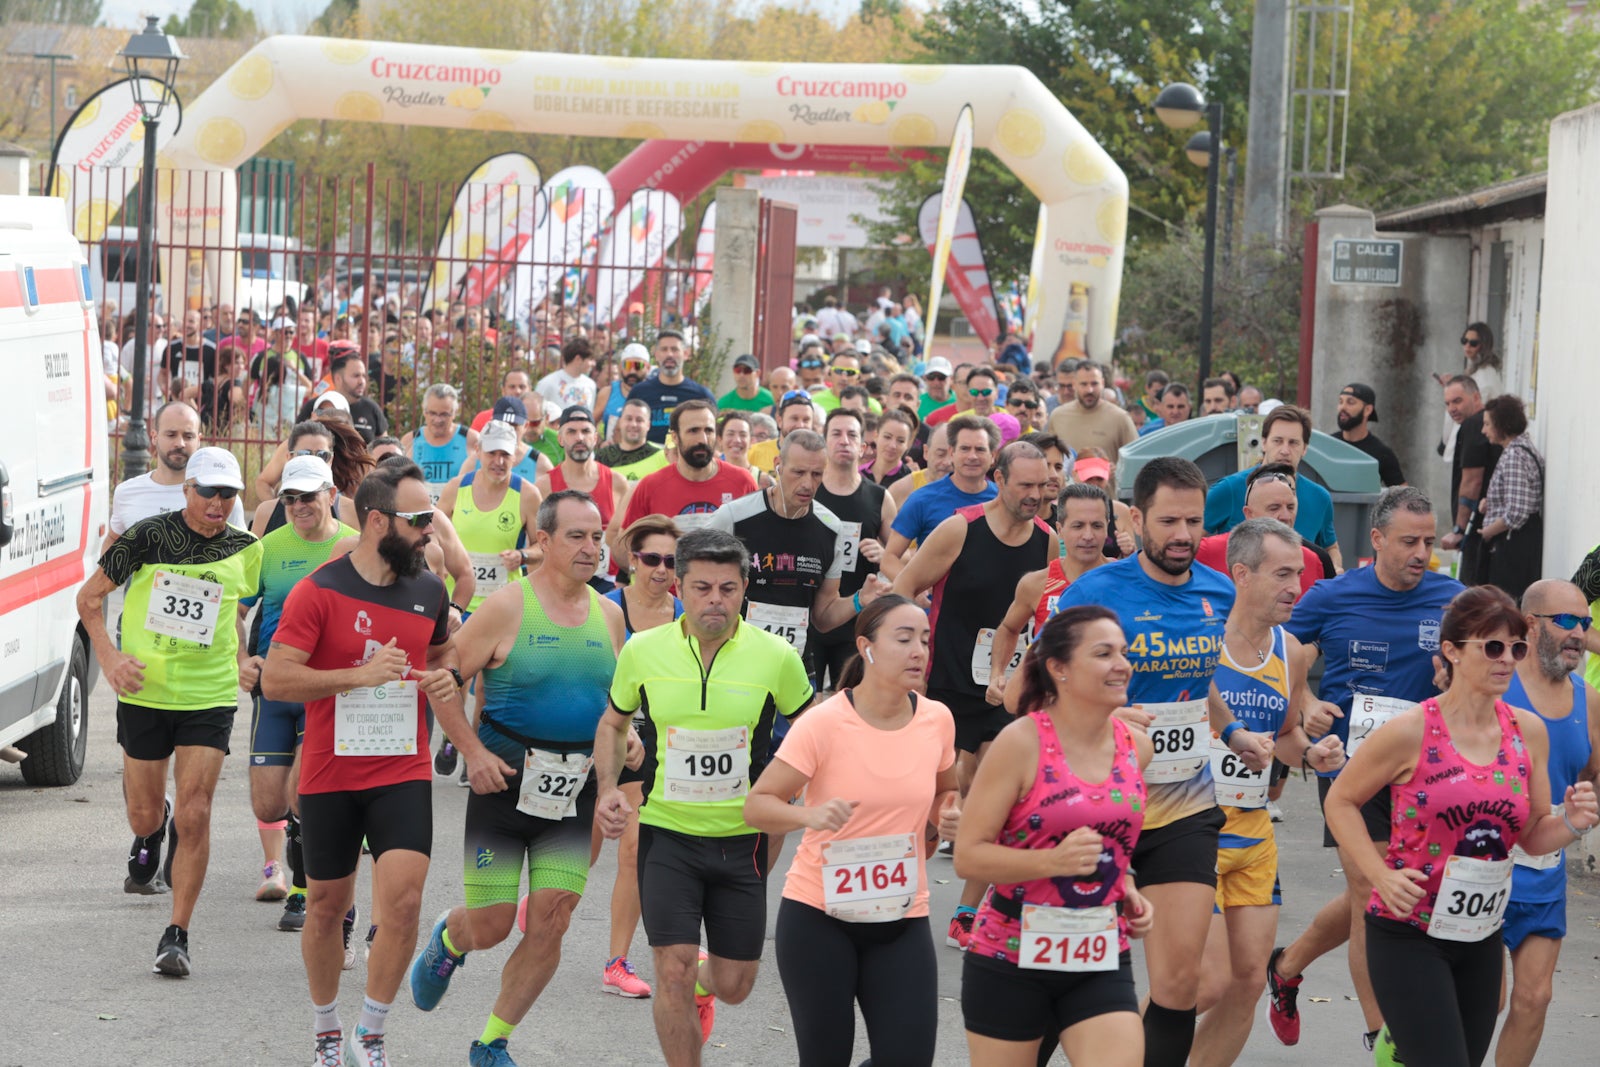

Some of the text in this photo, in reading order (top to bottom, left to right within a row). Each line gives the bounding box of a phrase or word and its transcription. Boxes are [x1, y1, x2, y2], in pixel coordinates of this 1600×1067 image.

[370, 56, 502, 87] Cruzcampo
[382, 85, 446, 108] Radler
[533, 75, 561, 91] CON
[566, 77, 604, 94] ZUMO
[608, 79, 669, 97] NATURAL
[674, 81, 692, 97] DE
[776, 75, 908, 101] Cruzcampo
[533, 95, 740, 119] DOBLEMENTE REFRESCANTE
[788, 103, 852, 125] Radler
[1356, 244, 1394, 256] CALLE
[9, 526, 25, 561] Cruz
[25, 512, 39, 566] Roja
[163, 595, 204, 620] 333
[1129, 632, 1167, 658] 45
[1174, 669, 1192, 679] Run
[1192, 669, 1205, 679] for
[1220, 688, 1285, 712] gustinos
[345, 713, 405, 724] YO CORRO CONTRA
[358, 724, 393, 736] EL CÁNCER
[1152, 727, 1195, 754] 689
[685, 753, 733, 777] 190
[1221, 754, 1263, 780] 62
[1425, 765, 1465, 785] KAMUABU
[537, 774, 578, 797] 322
[1040, 787, 1080, 808] KAMUABU
[1436, 797, 1522, 834] Monstruo
[1047, 818, 1134, 856] nstruo
[835, 861, 908, 894] 2164
[1032, 935, 1107, 964] 2149
